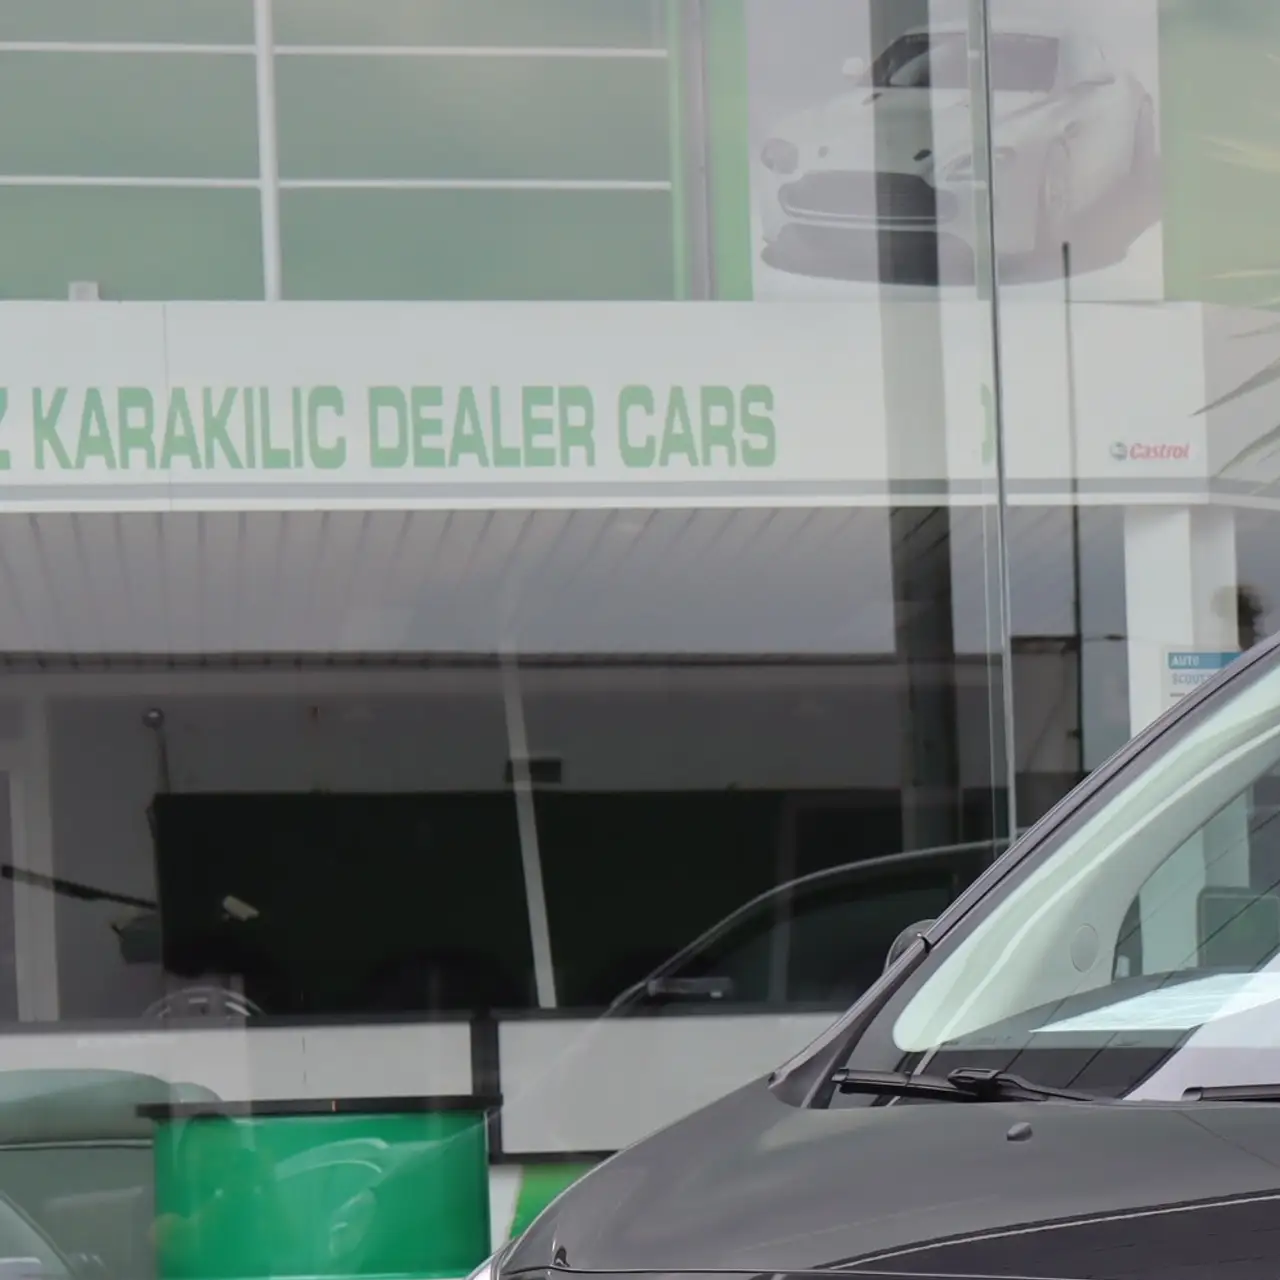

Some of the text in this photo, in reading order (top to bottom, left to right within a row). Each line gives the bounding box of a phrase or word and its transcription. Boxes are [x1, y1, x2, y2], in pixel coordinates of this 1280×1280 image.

[32, 385, 347, 470] KARAKILIC
[366, 385, 596, 468] DEALER
[617, 384, 776, 468] CARS
[1129, 442, 1190, 460] Castrol
